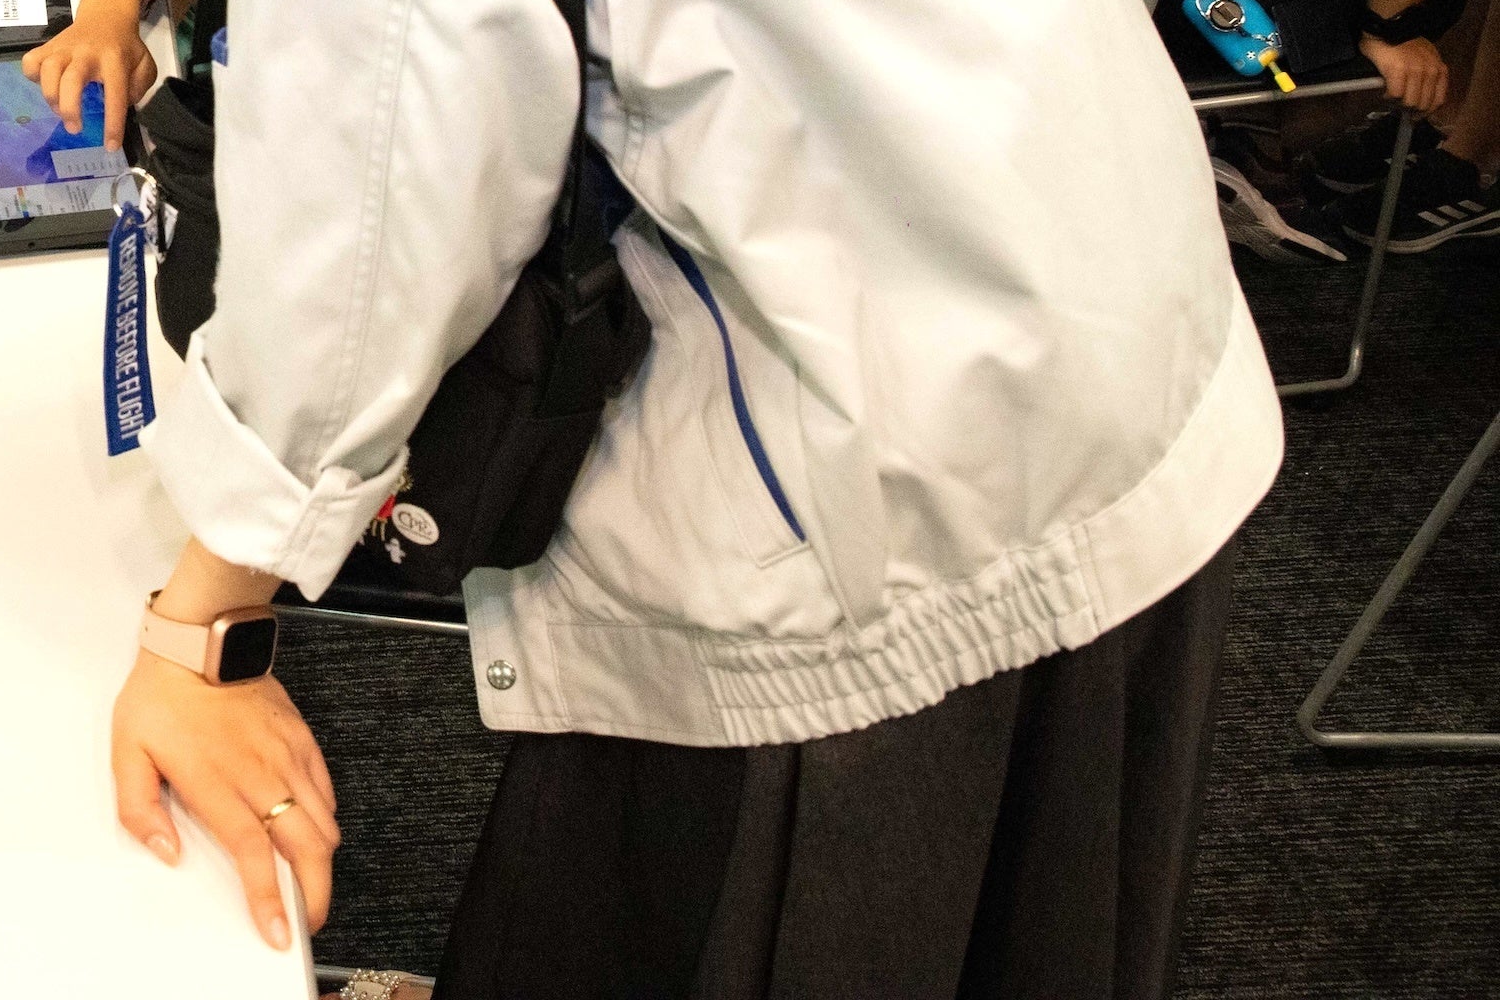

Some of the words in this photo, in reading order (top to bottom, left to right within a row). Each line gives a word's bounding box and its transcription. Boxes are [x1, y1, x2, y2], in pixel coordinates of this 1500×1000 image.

[118, 233, 139, 314] REMOVE
[116, 308, 138, 380] BEFORE
[117, 379, 145, 440] FLIGHT
